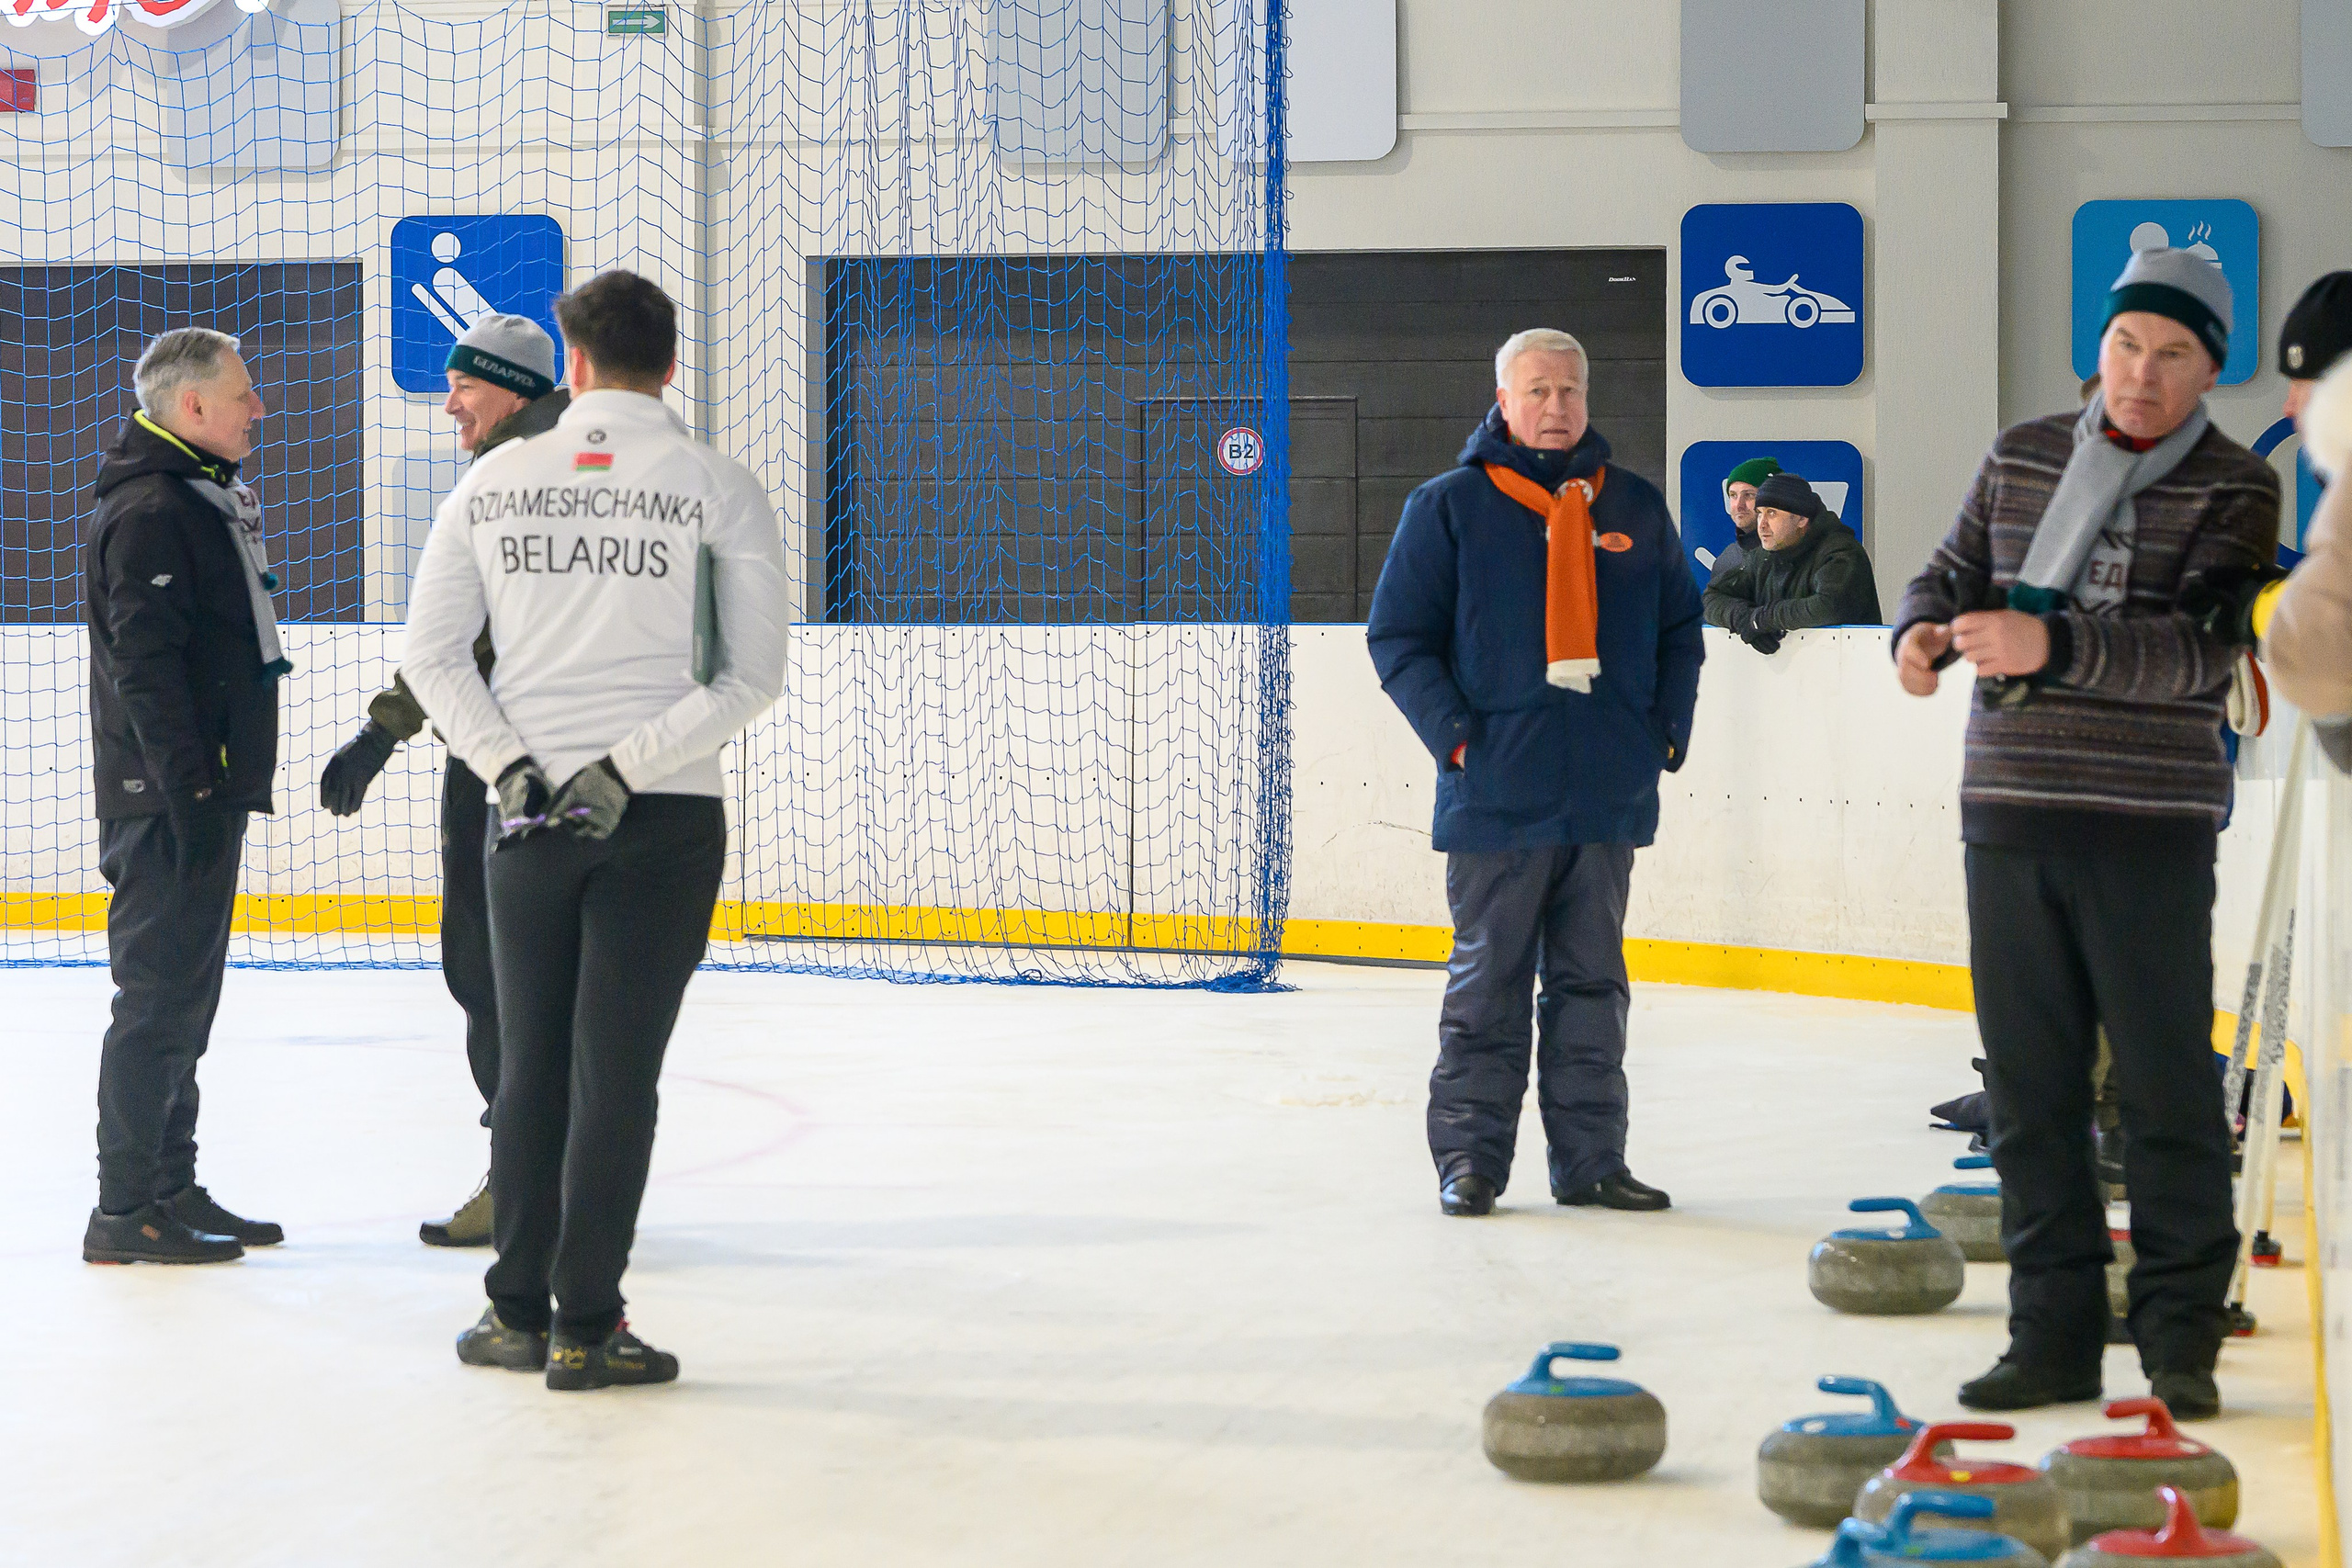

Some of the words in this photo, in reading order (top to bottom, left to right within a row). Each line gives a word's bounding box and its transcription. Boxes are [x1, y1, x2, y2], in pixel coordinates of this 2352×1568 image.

[1229, 444, 1254, 459] B2
[469, 487, 704, 529] DZIAMESHCHANKA
[501, 535, 669, 578] BELARUS
